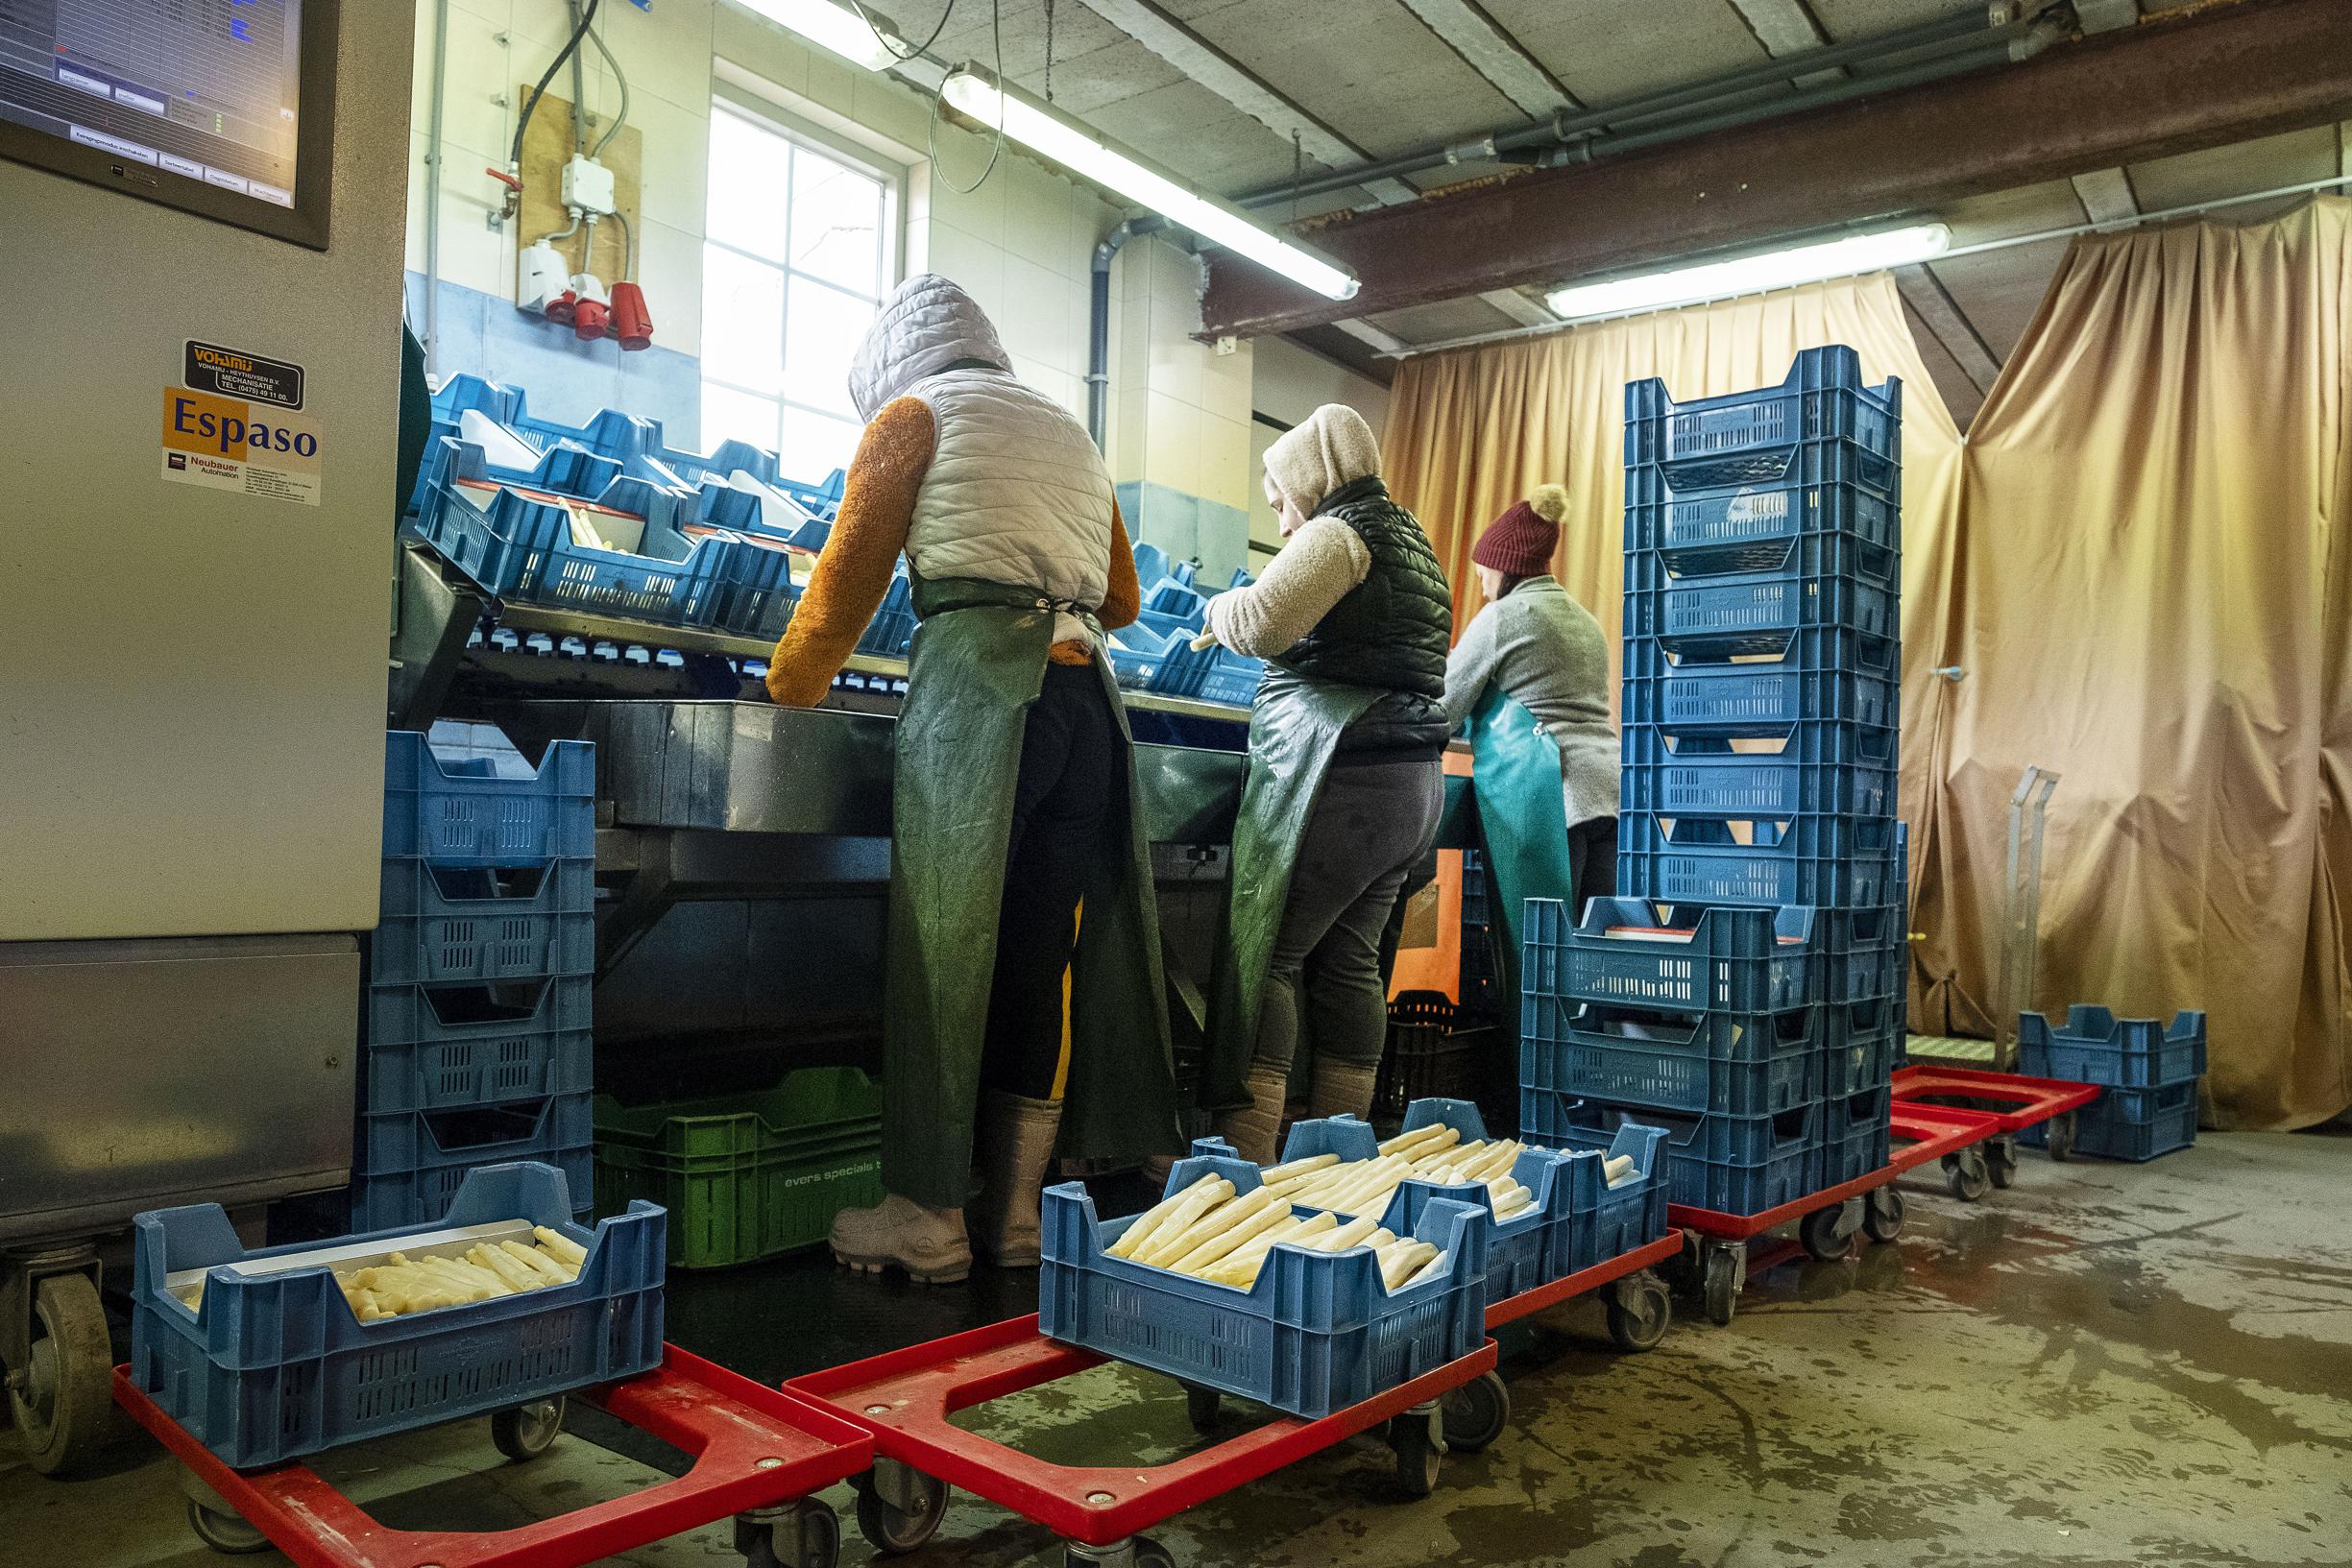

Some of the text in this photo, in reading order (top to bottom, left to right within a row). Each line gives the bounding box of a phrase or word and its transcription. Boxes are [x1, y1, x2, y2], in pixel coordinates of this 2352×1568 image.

[221, 374, 274, 392] MECHANISATIE
[230, 370, 269, 383] HEYTHUYSEN
[221, 380, 236, 391] TEL.
[238, 384, 259, 396] (0475)
[174, 397, 318, 458] Espaso
[190, 456, 239, 472] Neubauer
[201, 467, 239, 479] Automation
[785, 1173, 822, 1188] evers
[823, 1162, 874, 1181] specials
